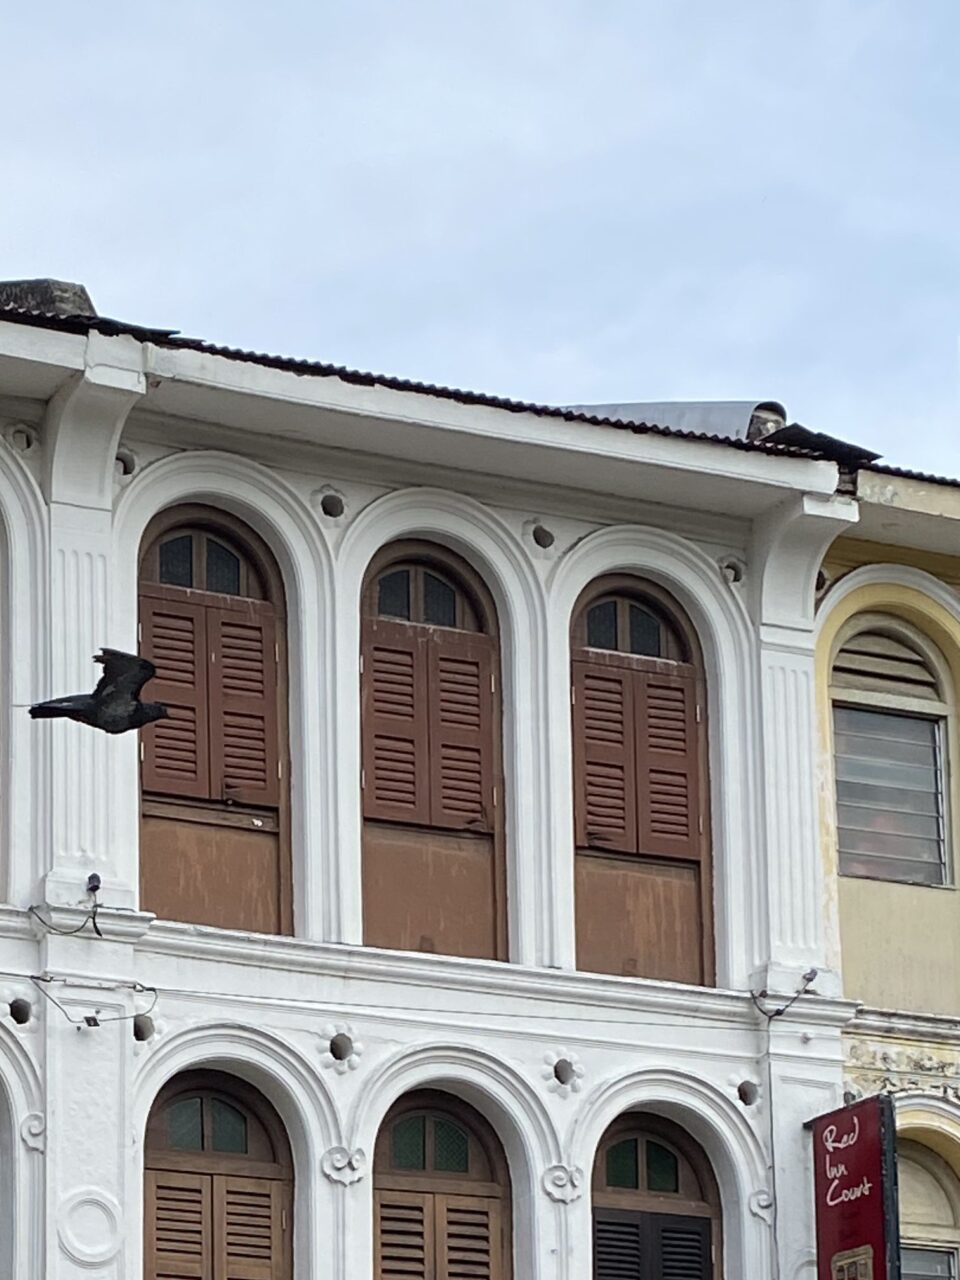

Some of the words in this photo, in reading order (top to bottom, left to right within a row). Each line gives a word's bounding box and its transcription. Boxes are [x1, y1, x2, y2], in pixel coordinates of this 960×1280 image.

[823, 1116, 859, 1152] Red
[826, 1154, 848, 1179] Inn
[827, 1176, 873, 1206] Court
